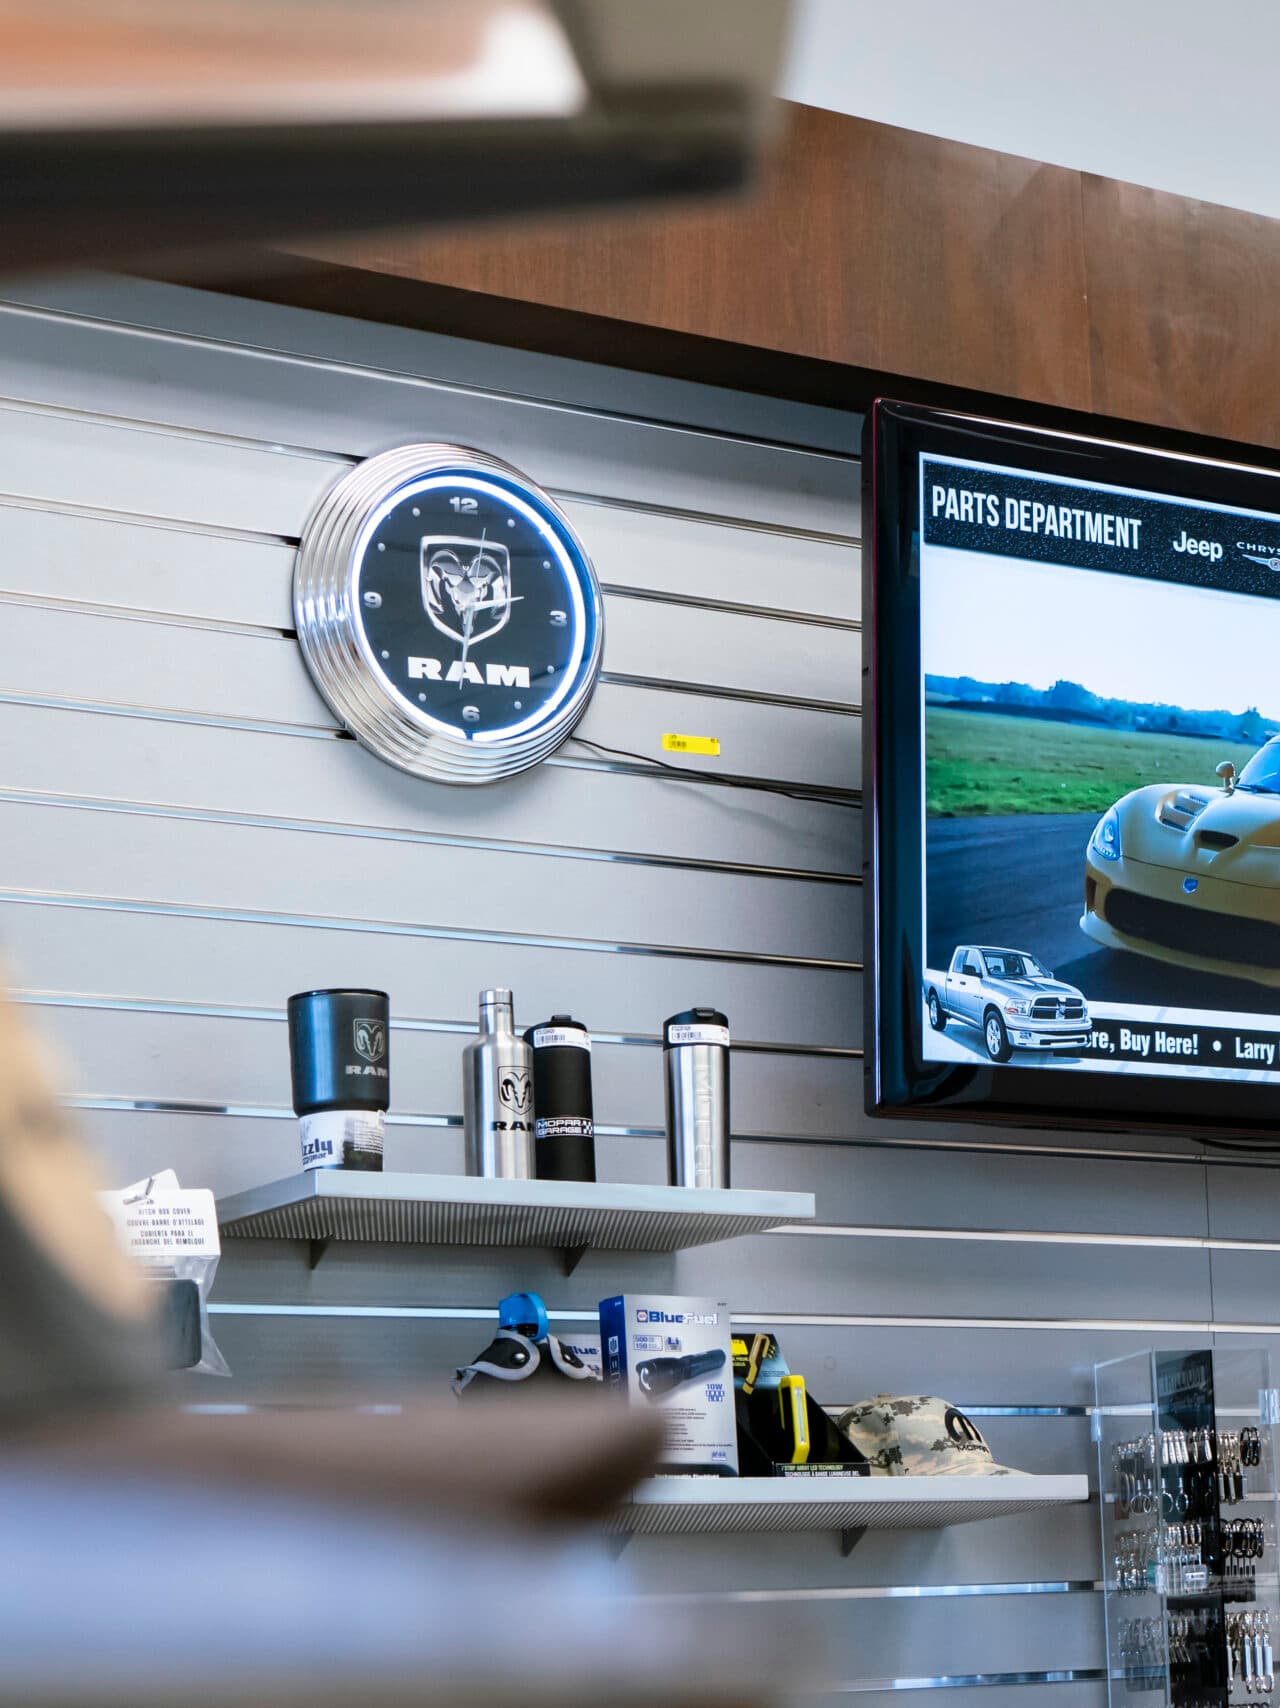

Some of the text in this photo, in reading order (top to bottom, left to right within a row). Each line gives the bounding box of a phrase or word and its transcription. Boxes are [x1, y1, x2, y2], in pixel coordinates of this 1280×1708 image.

[449, 496, 479, 515] 12
[932, 484, 1142, 550] PARTS DEPARTMENT
[1173, 531, 1223, 562] Jeep
[363, 591, 383, 609] 9
[549, 610, 567, 627] 3
[407, 656, 530, 689] RAM
[462, 704, 480, 723] 6
[1120, 1028, 1150, 1057] Buy
[1155, 1031, 1199, 1055] Here!
[1235, 1037, 1275, 1064] Larry
[537, 1119, 582, 1128] MOPAR
[537, 1126, 583, 1135] GARAGE
[650, 1310, 718, 1326] BlueFuel
